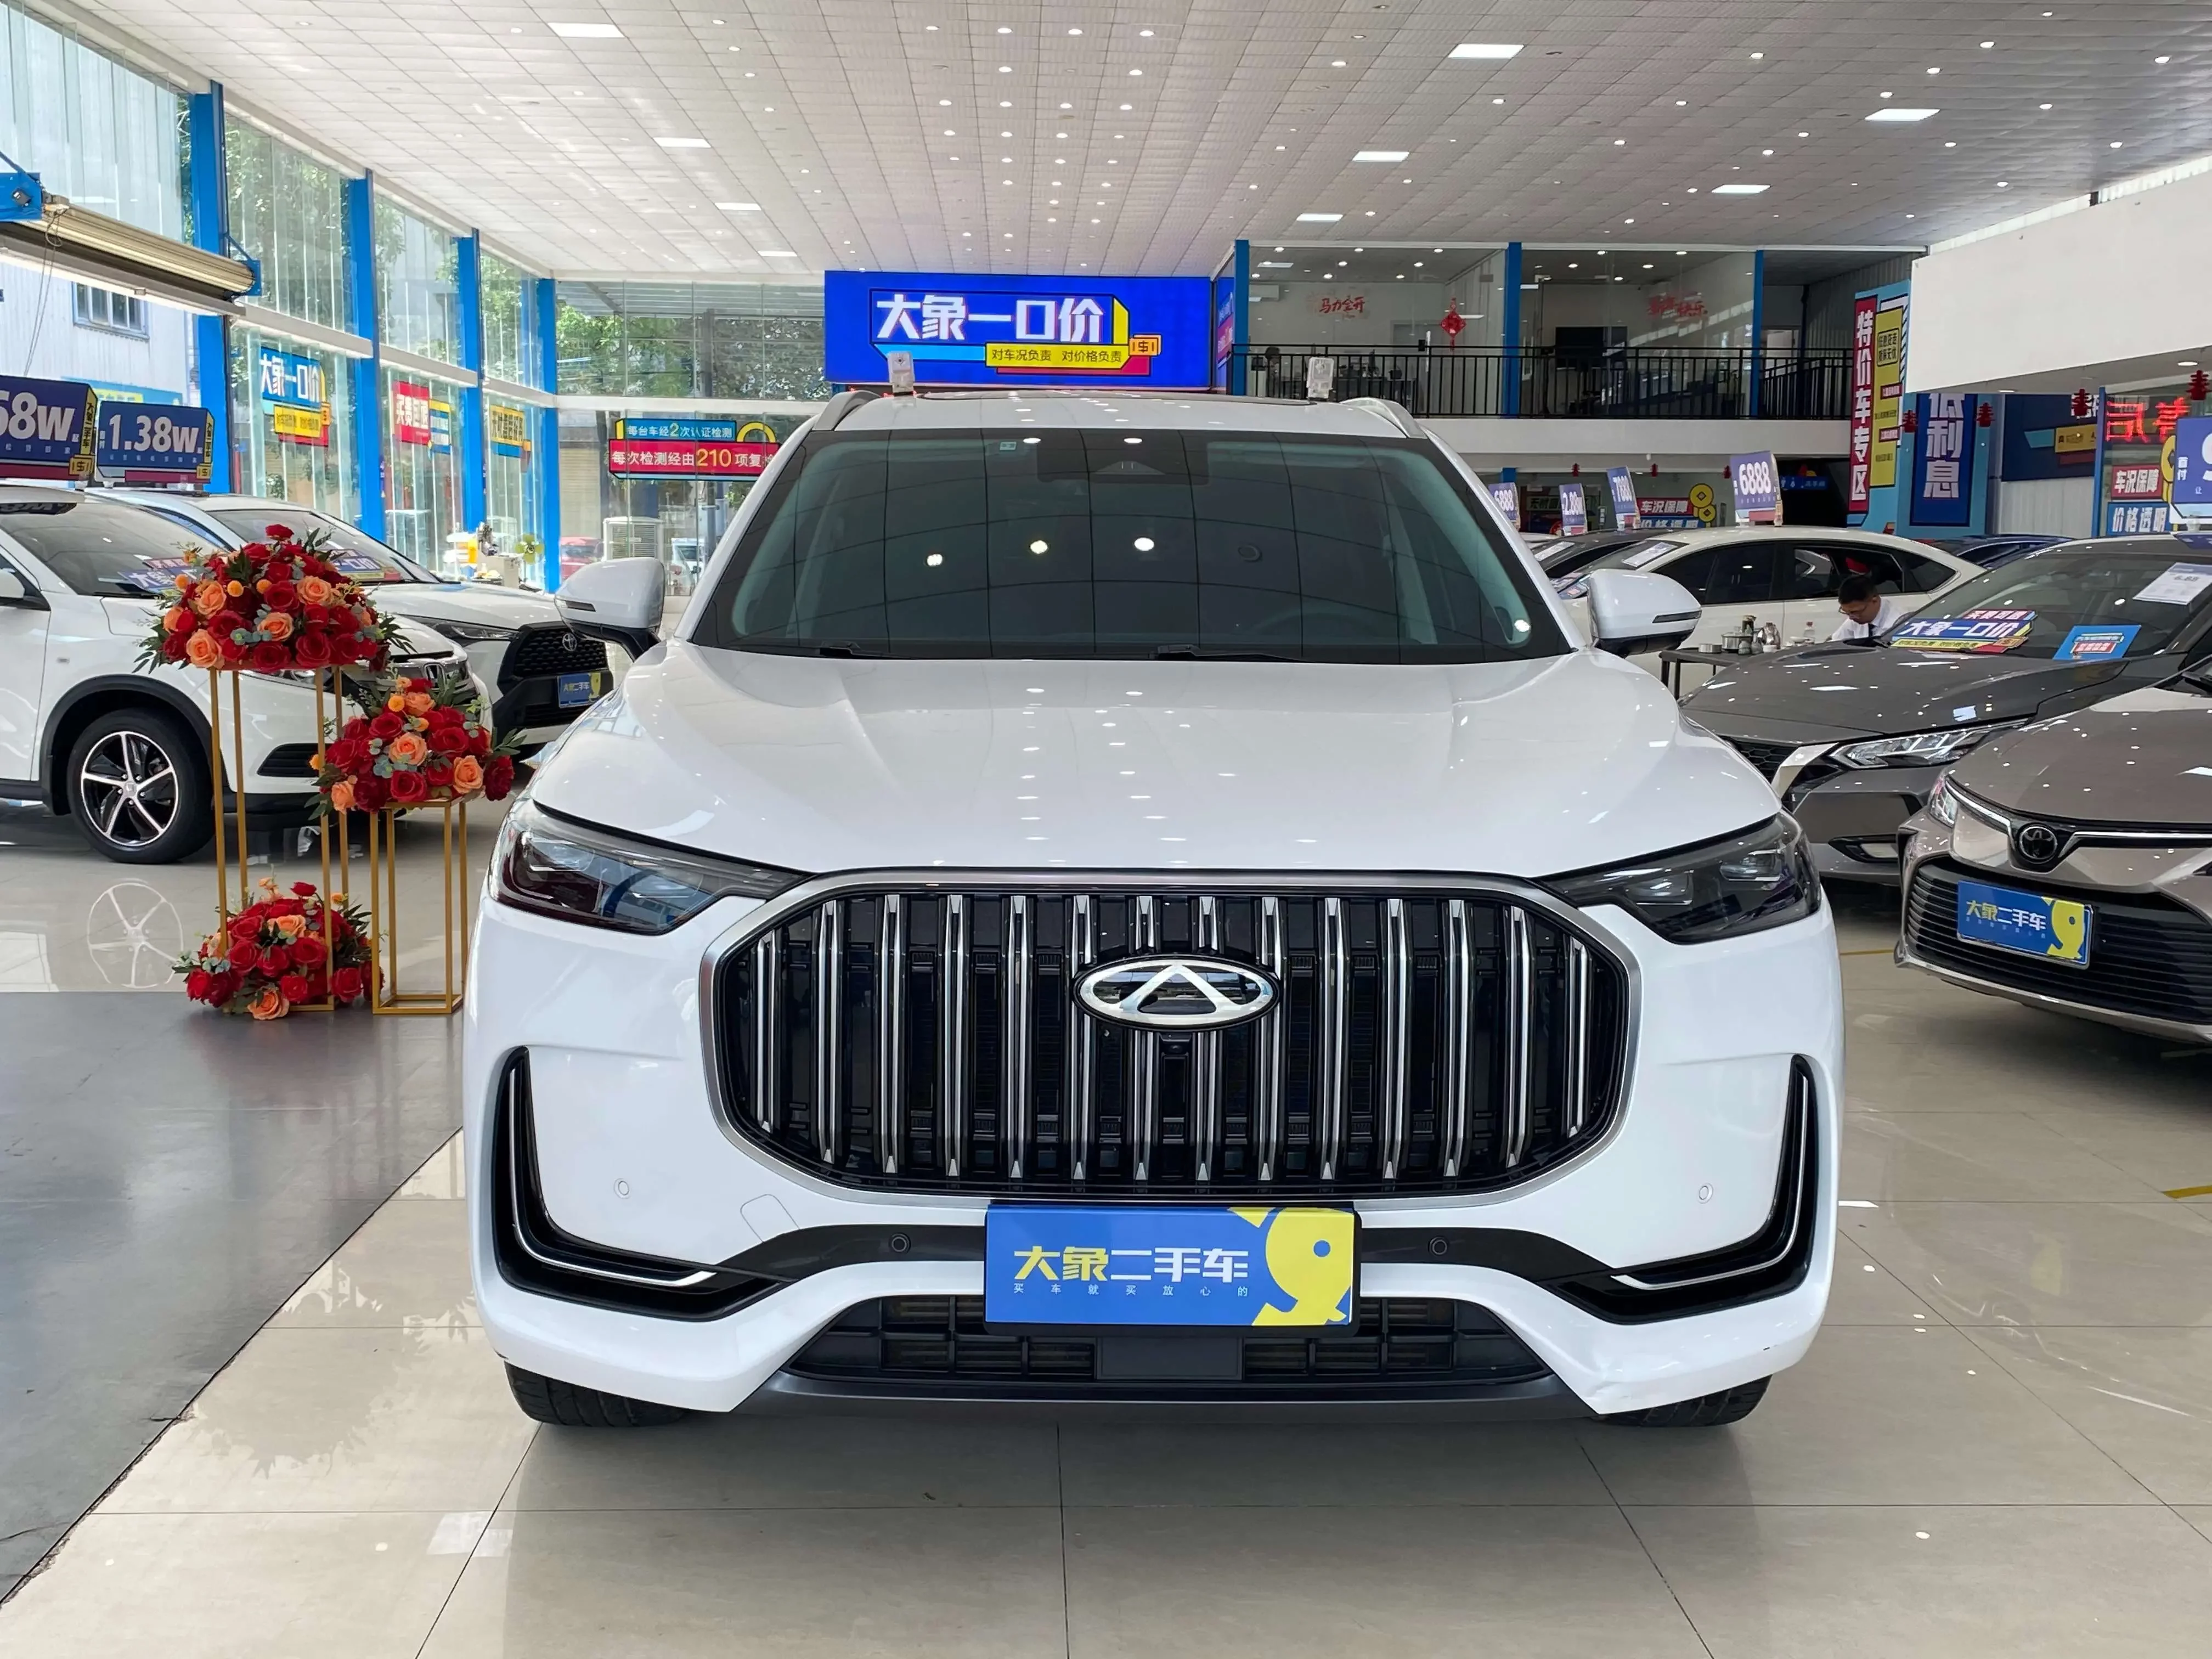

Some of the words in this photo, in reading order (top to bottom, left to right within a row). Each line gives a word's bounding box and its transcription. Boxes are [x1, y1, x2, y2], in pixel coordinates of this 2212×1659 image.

[877, 294, 1104, 343] 大象一口价
[992, 350, 1051, 362] 对车况负责
[1062, 350, 1122, 363] 对价格负责
[259, 353, 319, 403] 大象一口价
[1852, 309, 1874, 501] 特价车专区
[627, 422, 732, 438] 每台车经2次认证检测
[1923, 393, 1965, 498] 低利息
[1739, 461, 1771, 495] 6888
[2114, 469, 2160, 493] 车况保障
[1640, 500, 1689, 514] 车况保障
[2112, 507, 2168, 533] 价格透明
[1898, 621, 2020, 638] 大象一口价
[1966, 900, 2046, 931] 大象二手车
[1014, 1246, 1249, 1283] 大象二手车
[1013, 1283, 1249, 1297] 买车就买放心的
